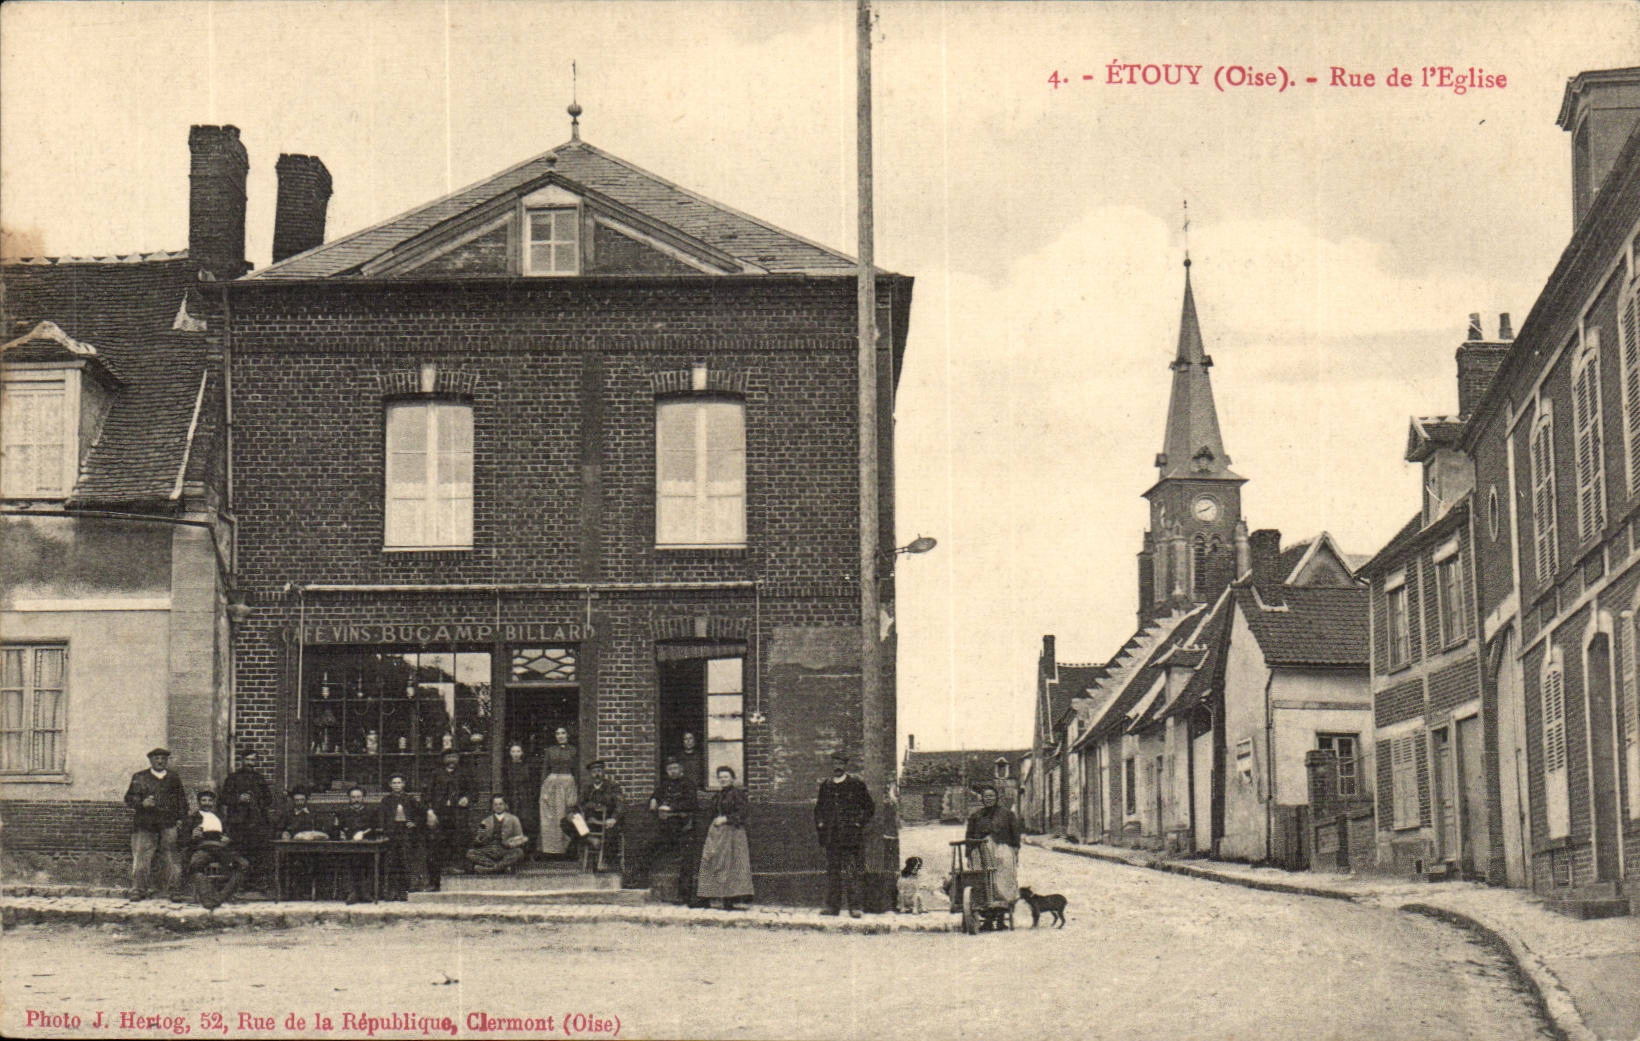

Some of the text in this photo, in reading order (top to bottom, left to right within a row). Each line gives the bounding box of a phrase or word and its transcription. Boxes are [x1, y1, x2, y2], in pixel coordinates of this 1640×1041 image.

[332, 625, 372, 642] VINS
[382, 625, 492, 643] BUCAMP
[505, 624, 596, 641] BILLARD
